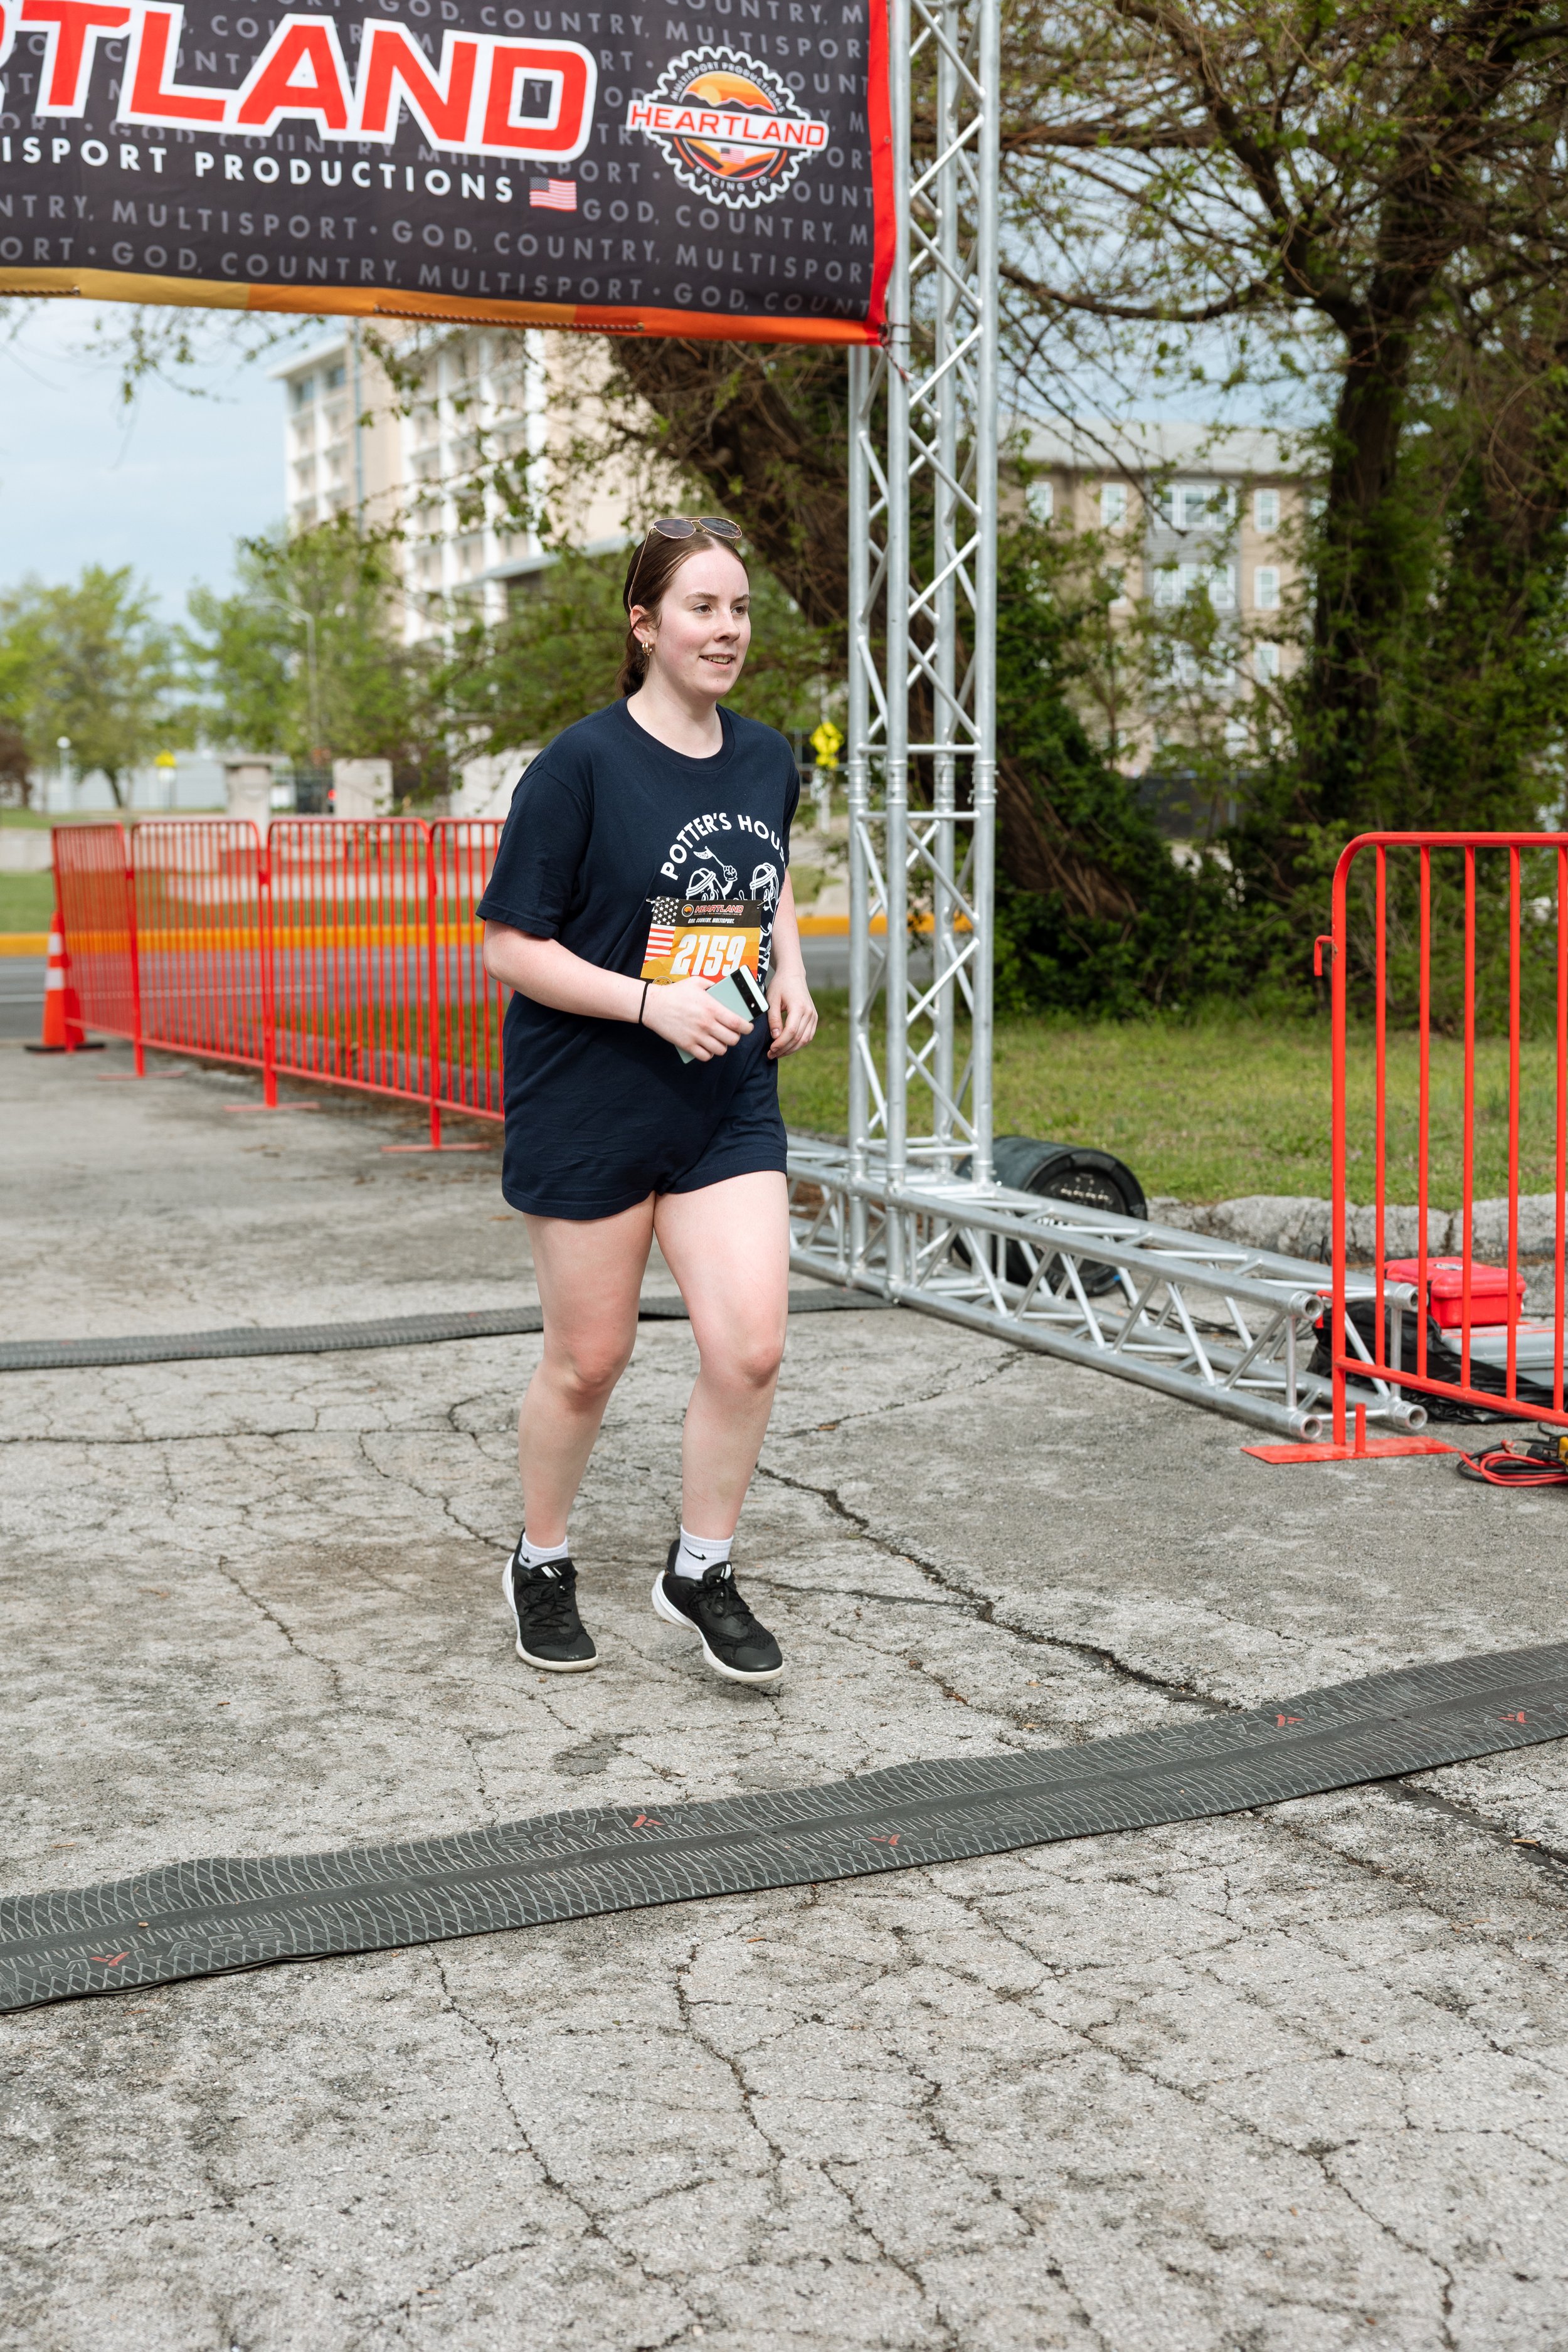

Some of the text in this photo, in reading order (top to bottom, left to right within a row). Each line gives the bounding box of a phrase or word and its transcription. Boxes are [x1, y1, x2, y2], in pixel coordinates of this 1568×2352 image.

[480, 6, 650, 38] COUNTRY,
[665, 20, 868, 60] MULTISPOR
[669, 0, 827, 25] UNTRY,
[0, 0, 598, 162] TLAND
[670, 61, 786, 114] MULTISPORT PRODUCTIONS
[630, 103, 827, 147] HEARTLAND
[195, 151, 512, 203] PRODUCTIONS
[694, 166, 745, 192] RACING
[112, 200, 356, 240] MULTISPORT
[391, 220, 477, 253] GOD,
[494, 231, 661, 264] COUNTRY,
[676, 245, 874, 284] MULTISPOR
[583, 200, 659, 225] GOD,
[675, 206, 837, 245] COUNTRY,
[112, 241, 202, 275] GOD,
[221, 252, 402, 283] COUNTRY,
[419, 265, 642, 300] MULTISPORT
[674, 283, 748, 310] GOD,
[660, 813, 785, 881] POTTER'S HOUS
[694, 904, 744, 913] HEARTLAND
[669, 934, 746, 977] 2159
